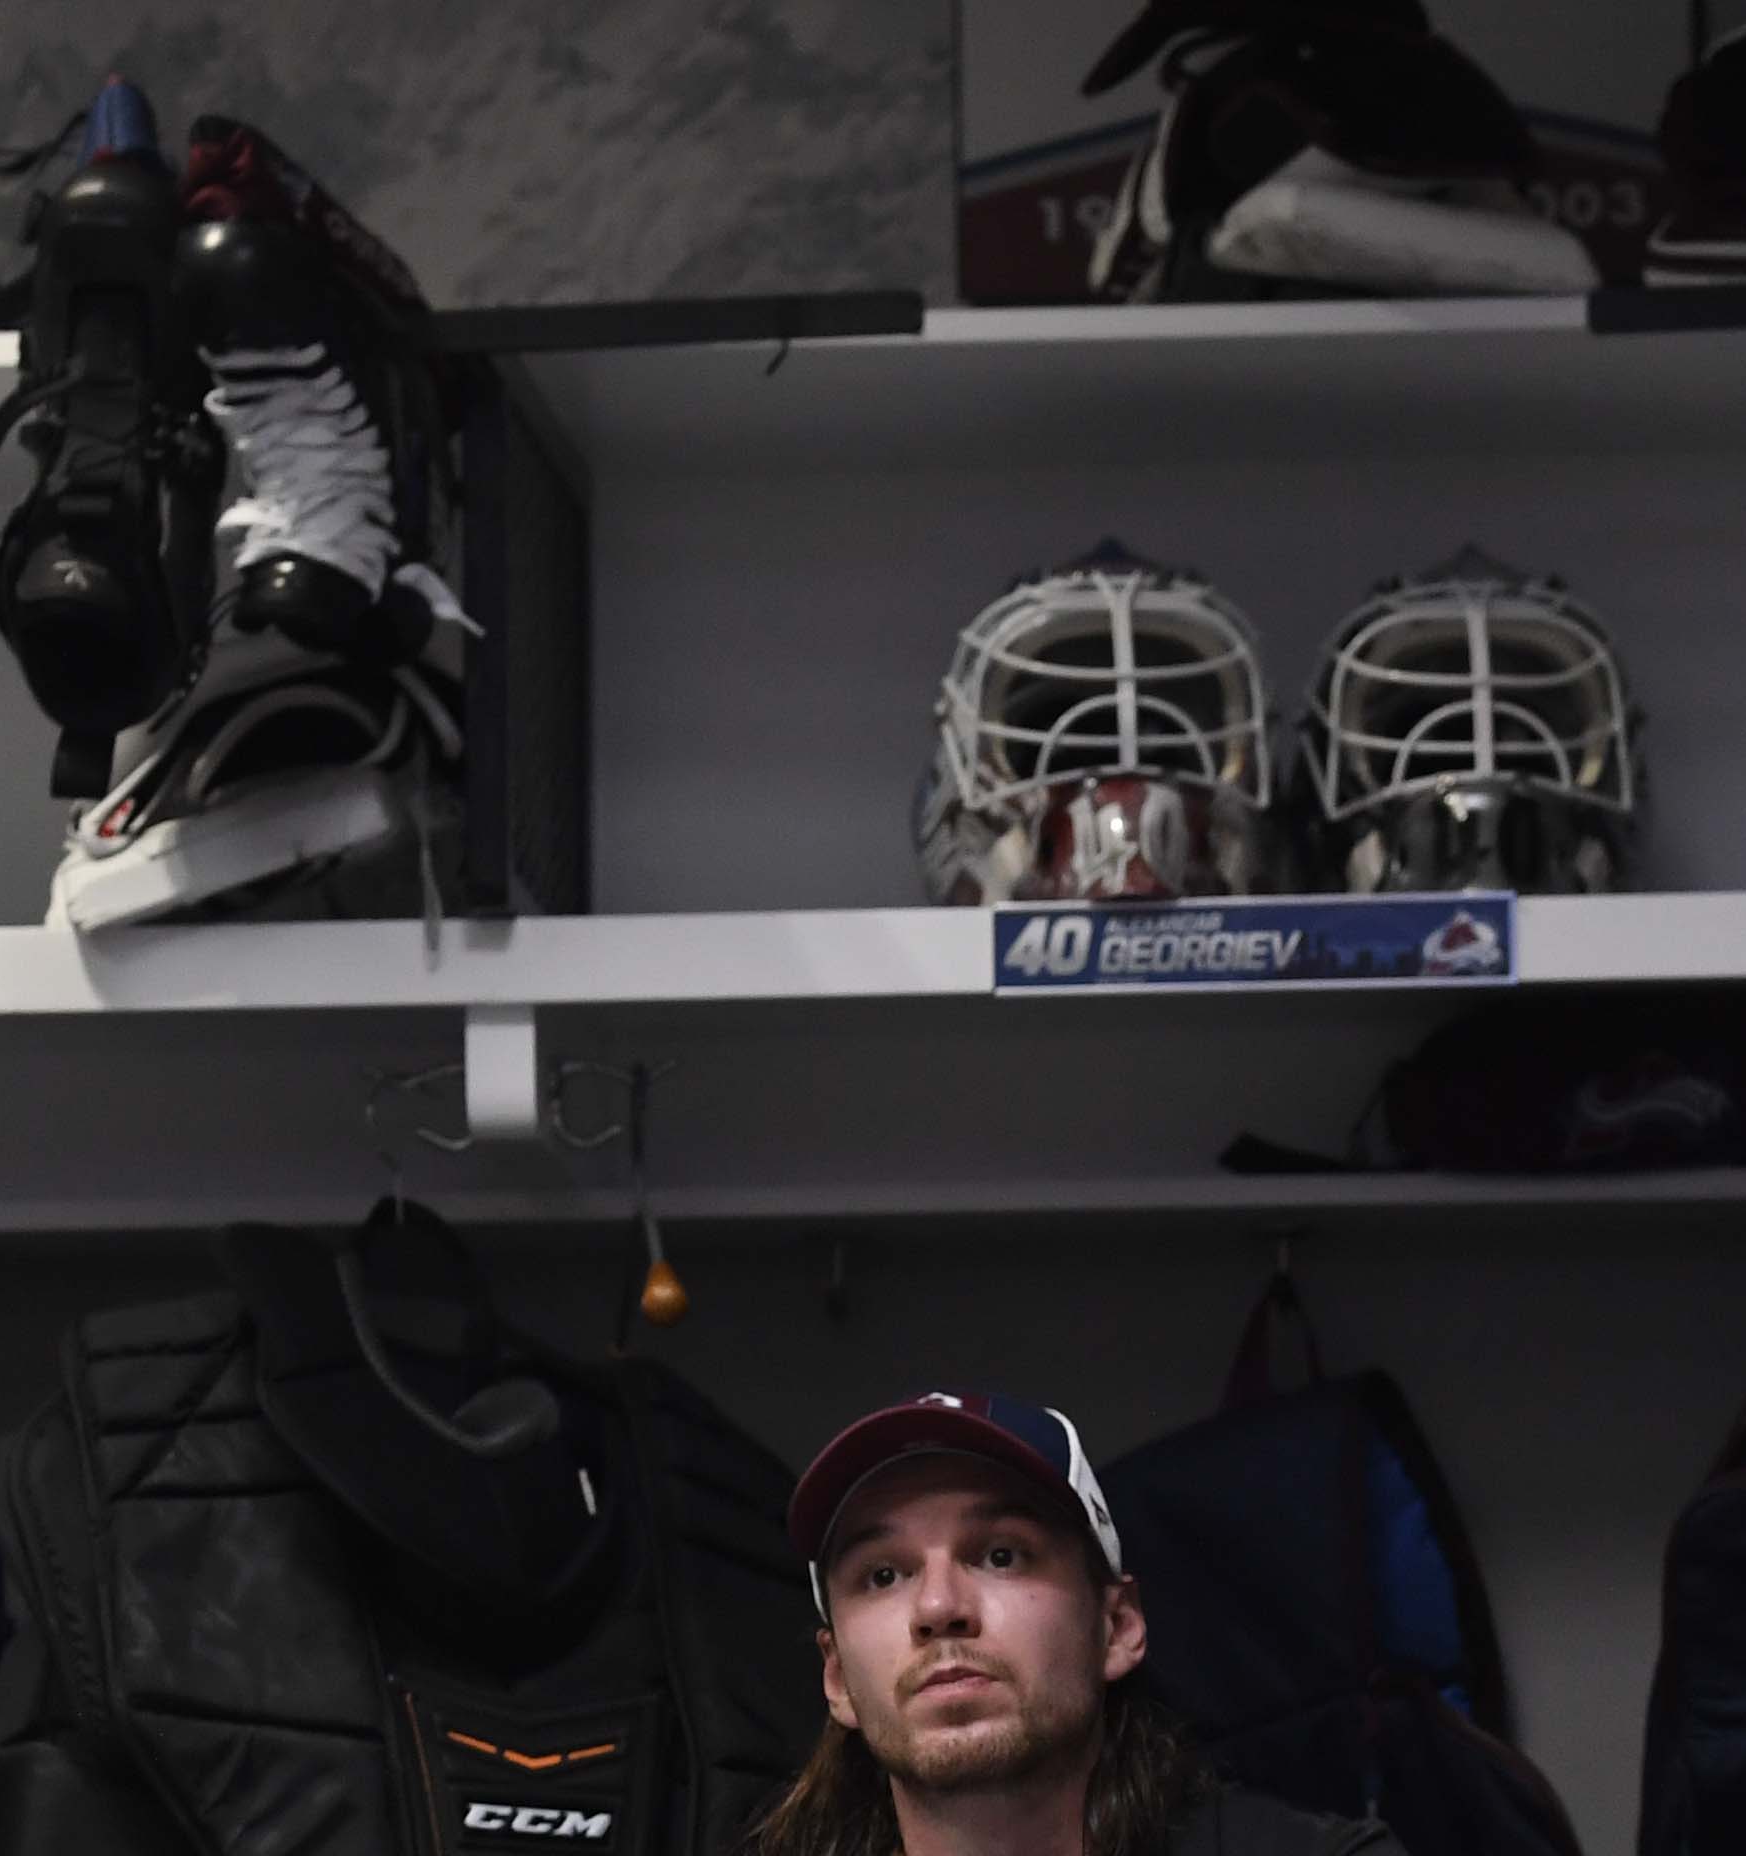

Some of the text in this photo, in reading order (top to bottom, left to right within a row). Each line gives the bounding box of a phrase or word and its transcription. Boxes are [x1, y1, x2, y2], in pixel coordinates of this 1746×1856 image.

[1004, 915, 1303, 976] 40 GEORGIEV
[463, 1801, 613, 1840] CCM
